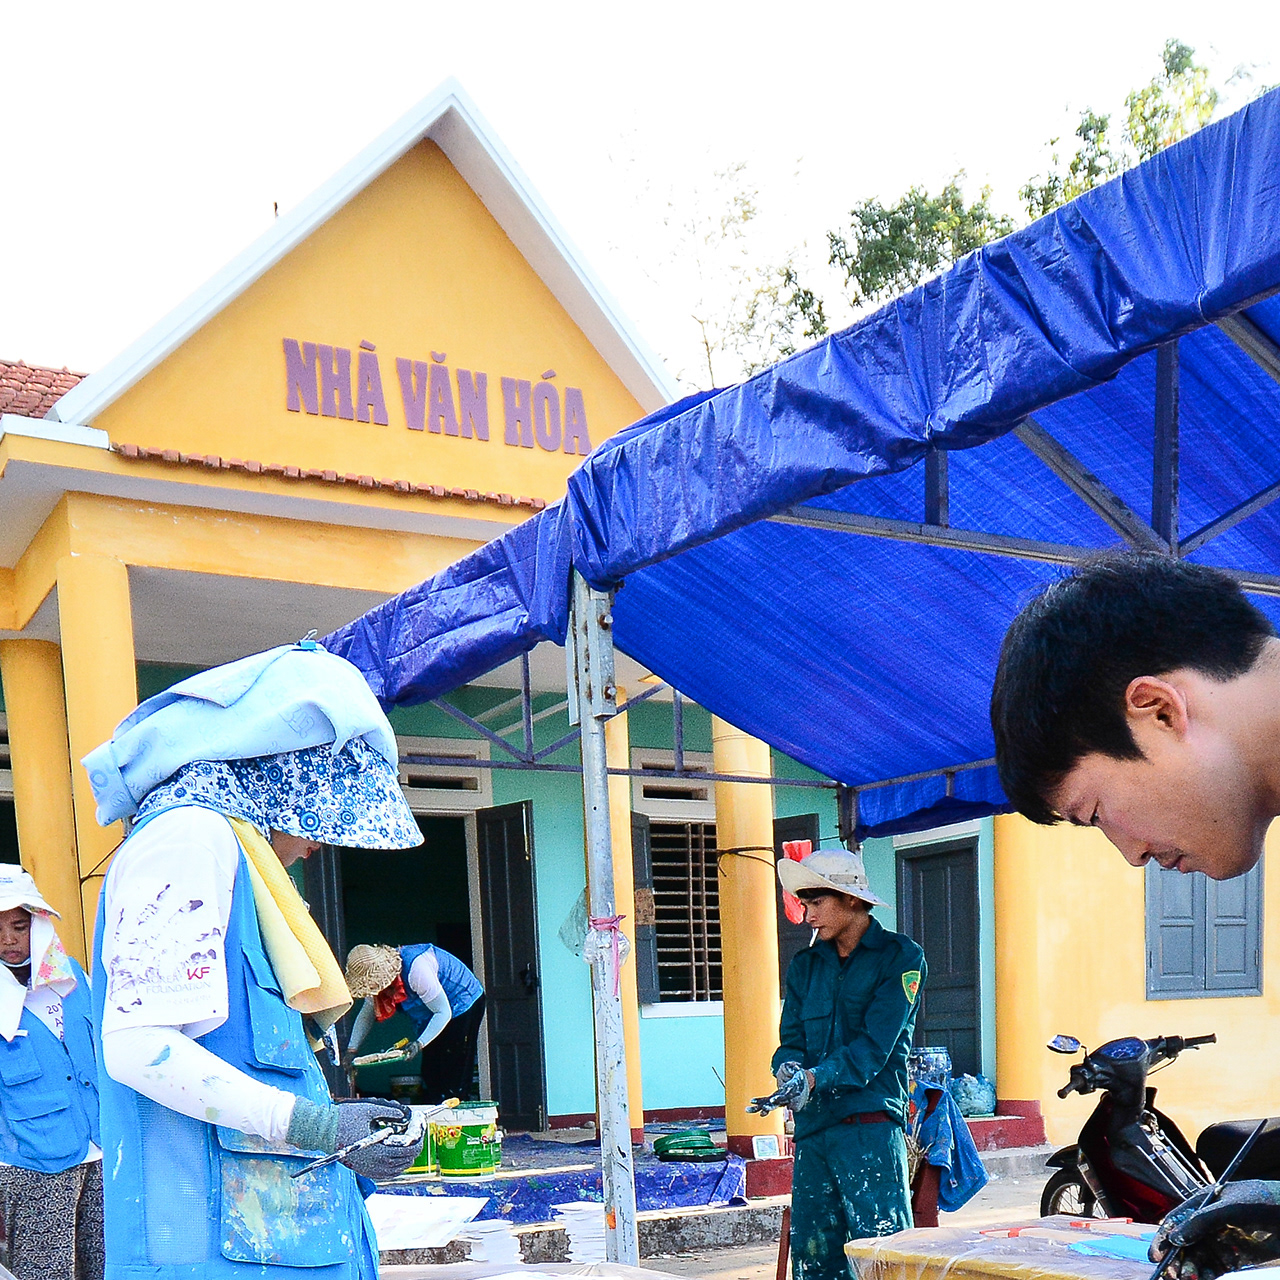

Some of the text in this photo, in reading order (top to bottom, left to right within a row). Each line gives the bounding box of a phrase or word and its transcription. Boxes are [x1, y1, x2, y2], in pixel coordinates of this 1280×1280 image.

[282, 338, 592, 456] NHÀ VĂN HÓA
[146, 981, 211, 994] FOUNDATION
